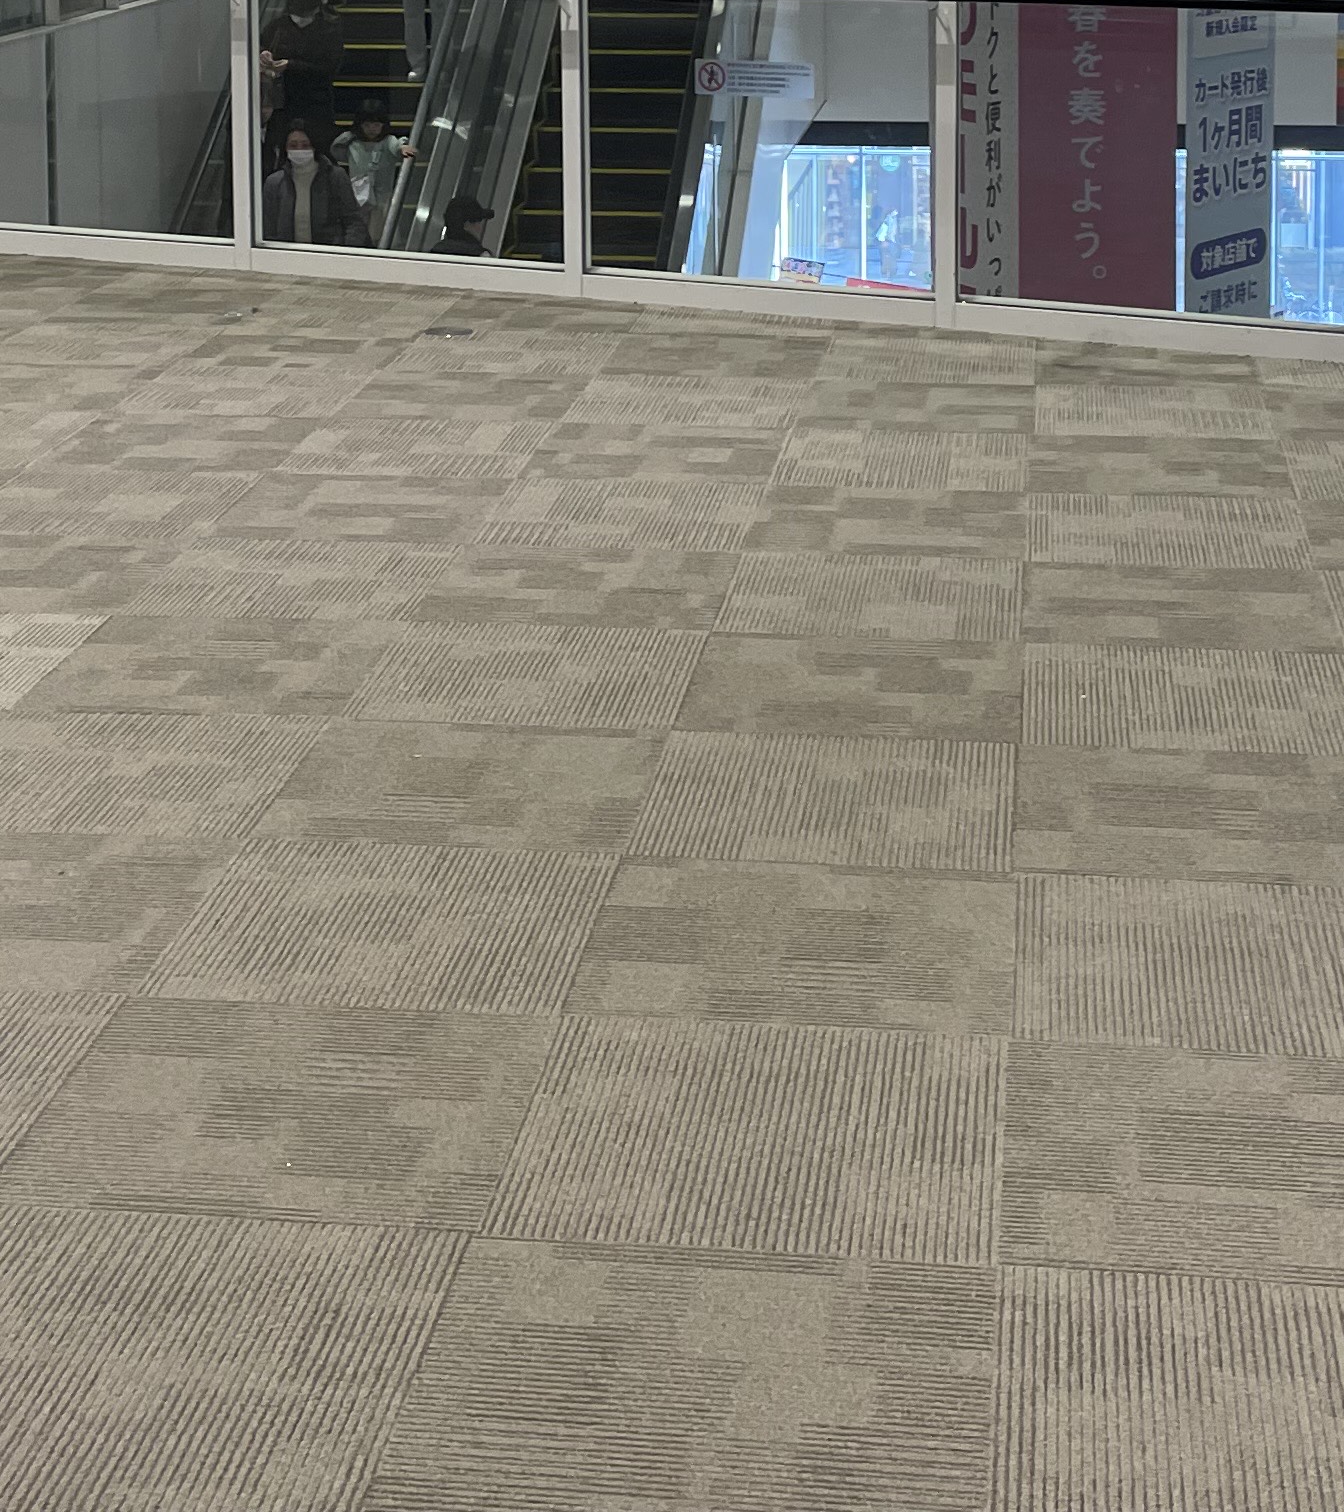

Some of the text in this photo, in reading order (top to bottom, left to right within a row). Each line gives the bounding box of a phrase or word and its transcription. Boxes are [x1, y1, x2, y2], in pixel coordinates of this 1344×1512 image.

[1194, 67, 1269, 103] カード発行後
[1192, 151, 1268, 204] まいにち
[1199, 236, 1258, 271] 対象店舗で
